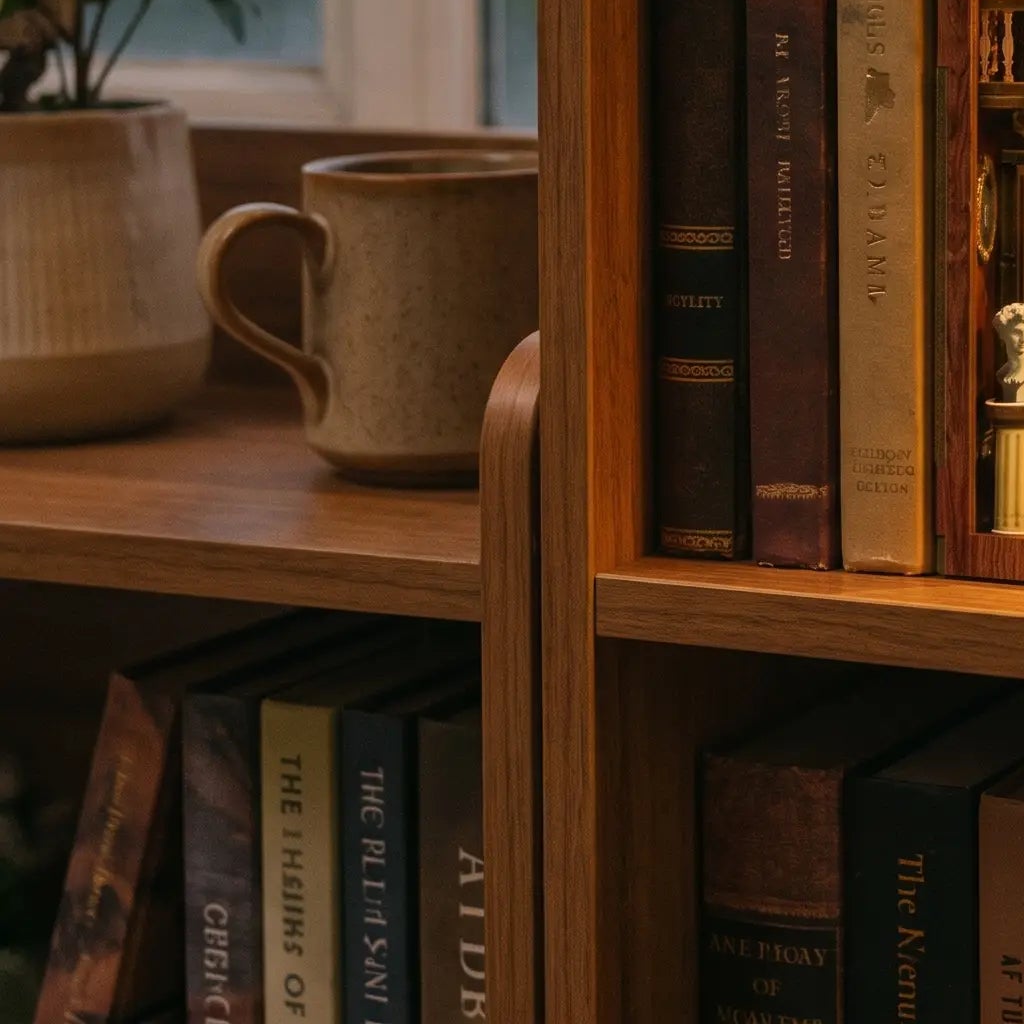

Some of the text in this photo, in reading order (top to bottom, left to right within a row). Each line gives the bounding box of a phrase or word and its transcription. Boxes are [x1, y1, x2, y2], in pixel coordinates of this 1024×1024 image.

[280, 754, 303, 815] THE
[896, 853, 927, 914] The
[283, 973, 306, 1018] OF
